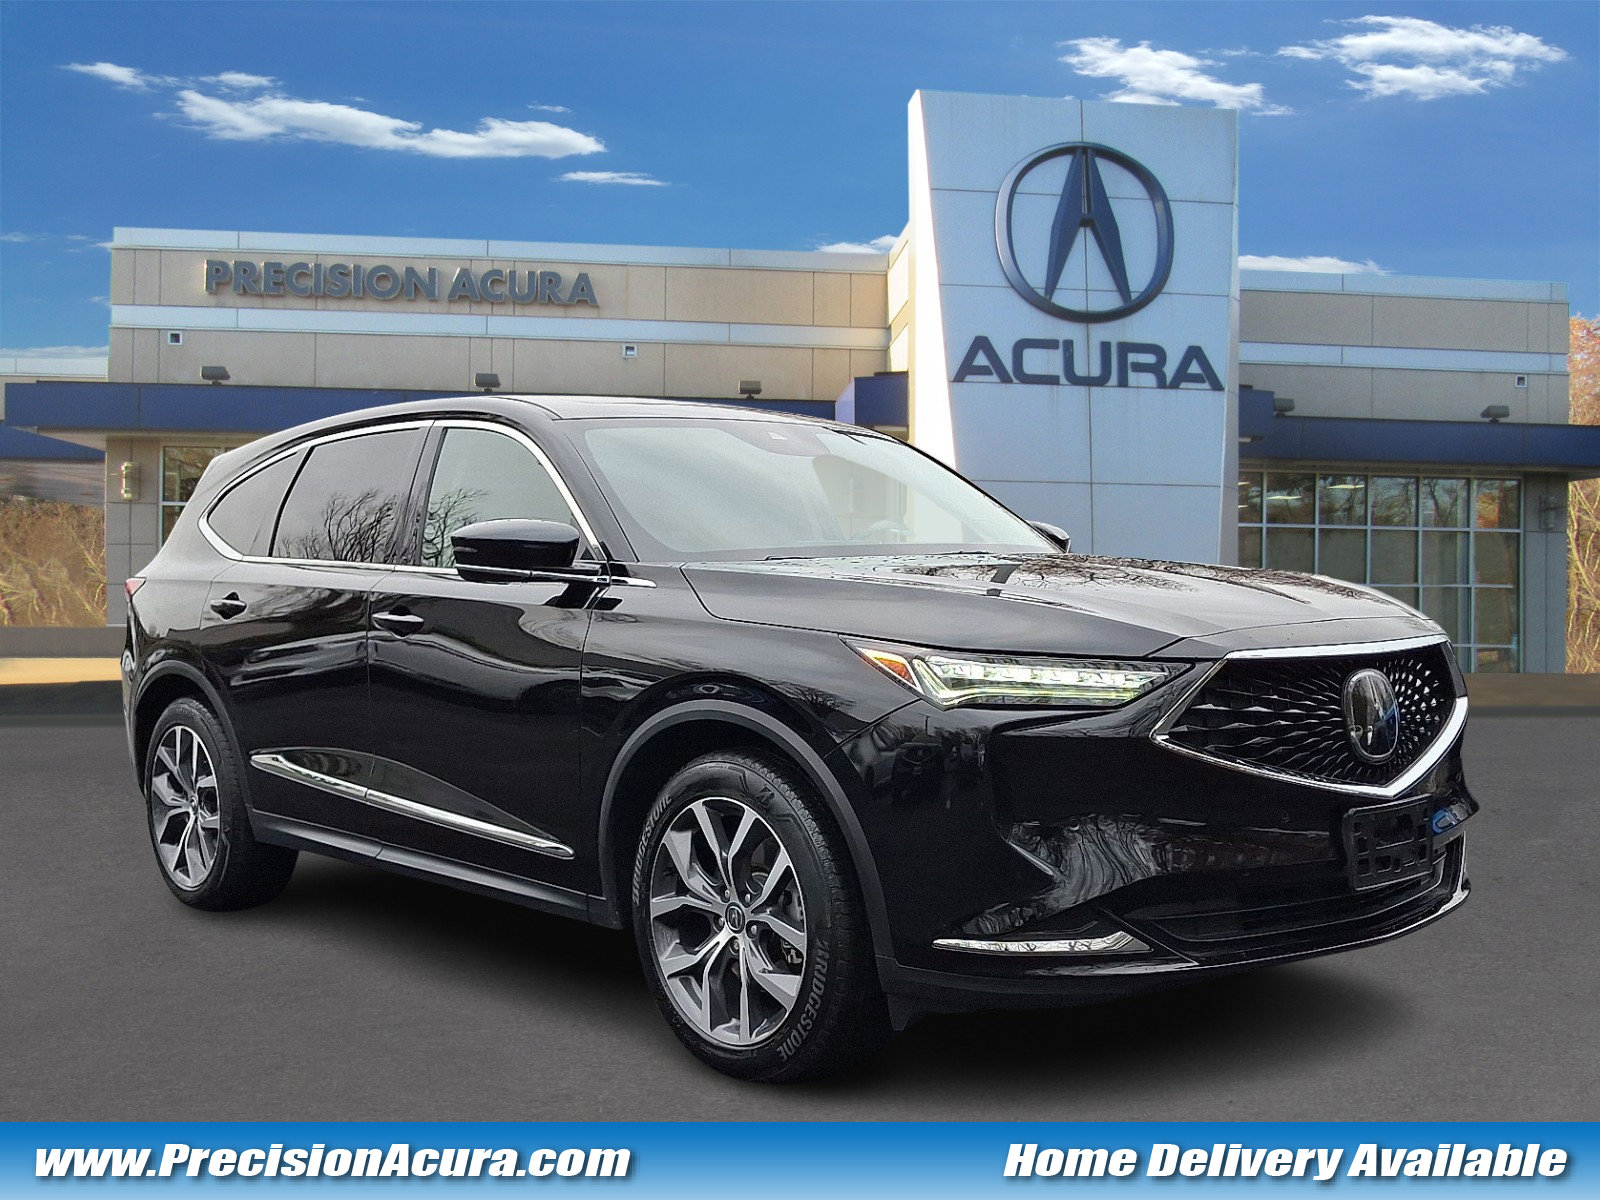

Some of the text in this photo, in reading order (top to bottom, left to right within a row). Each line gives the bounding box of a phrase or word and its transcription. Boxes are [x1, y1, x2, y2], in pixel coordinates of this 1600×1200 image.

[203, 258, 600, 308] PRECISION ACURA
[951, 335, 1225, 391] ACURA
[776, 938, 830, 1061] BRIDGESTONE
